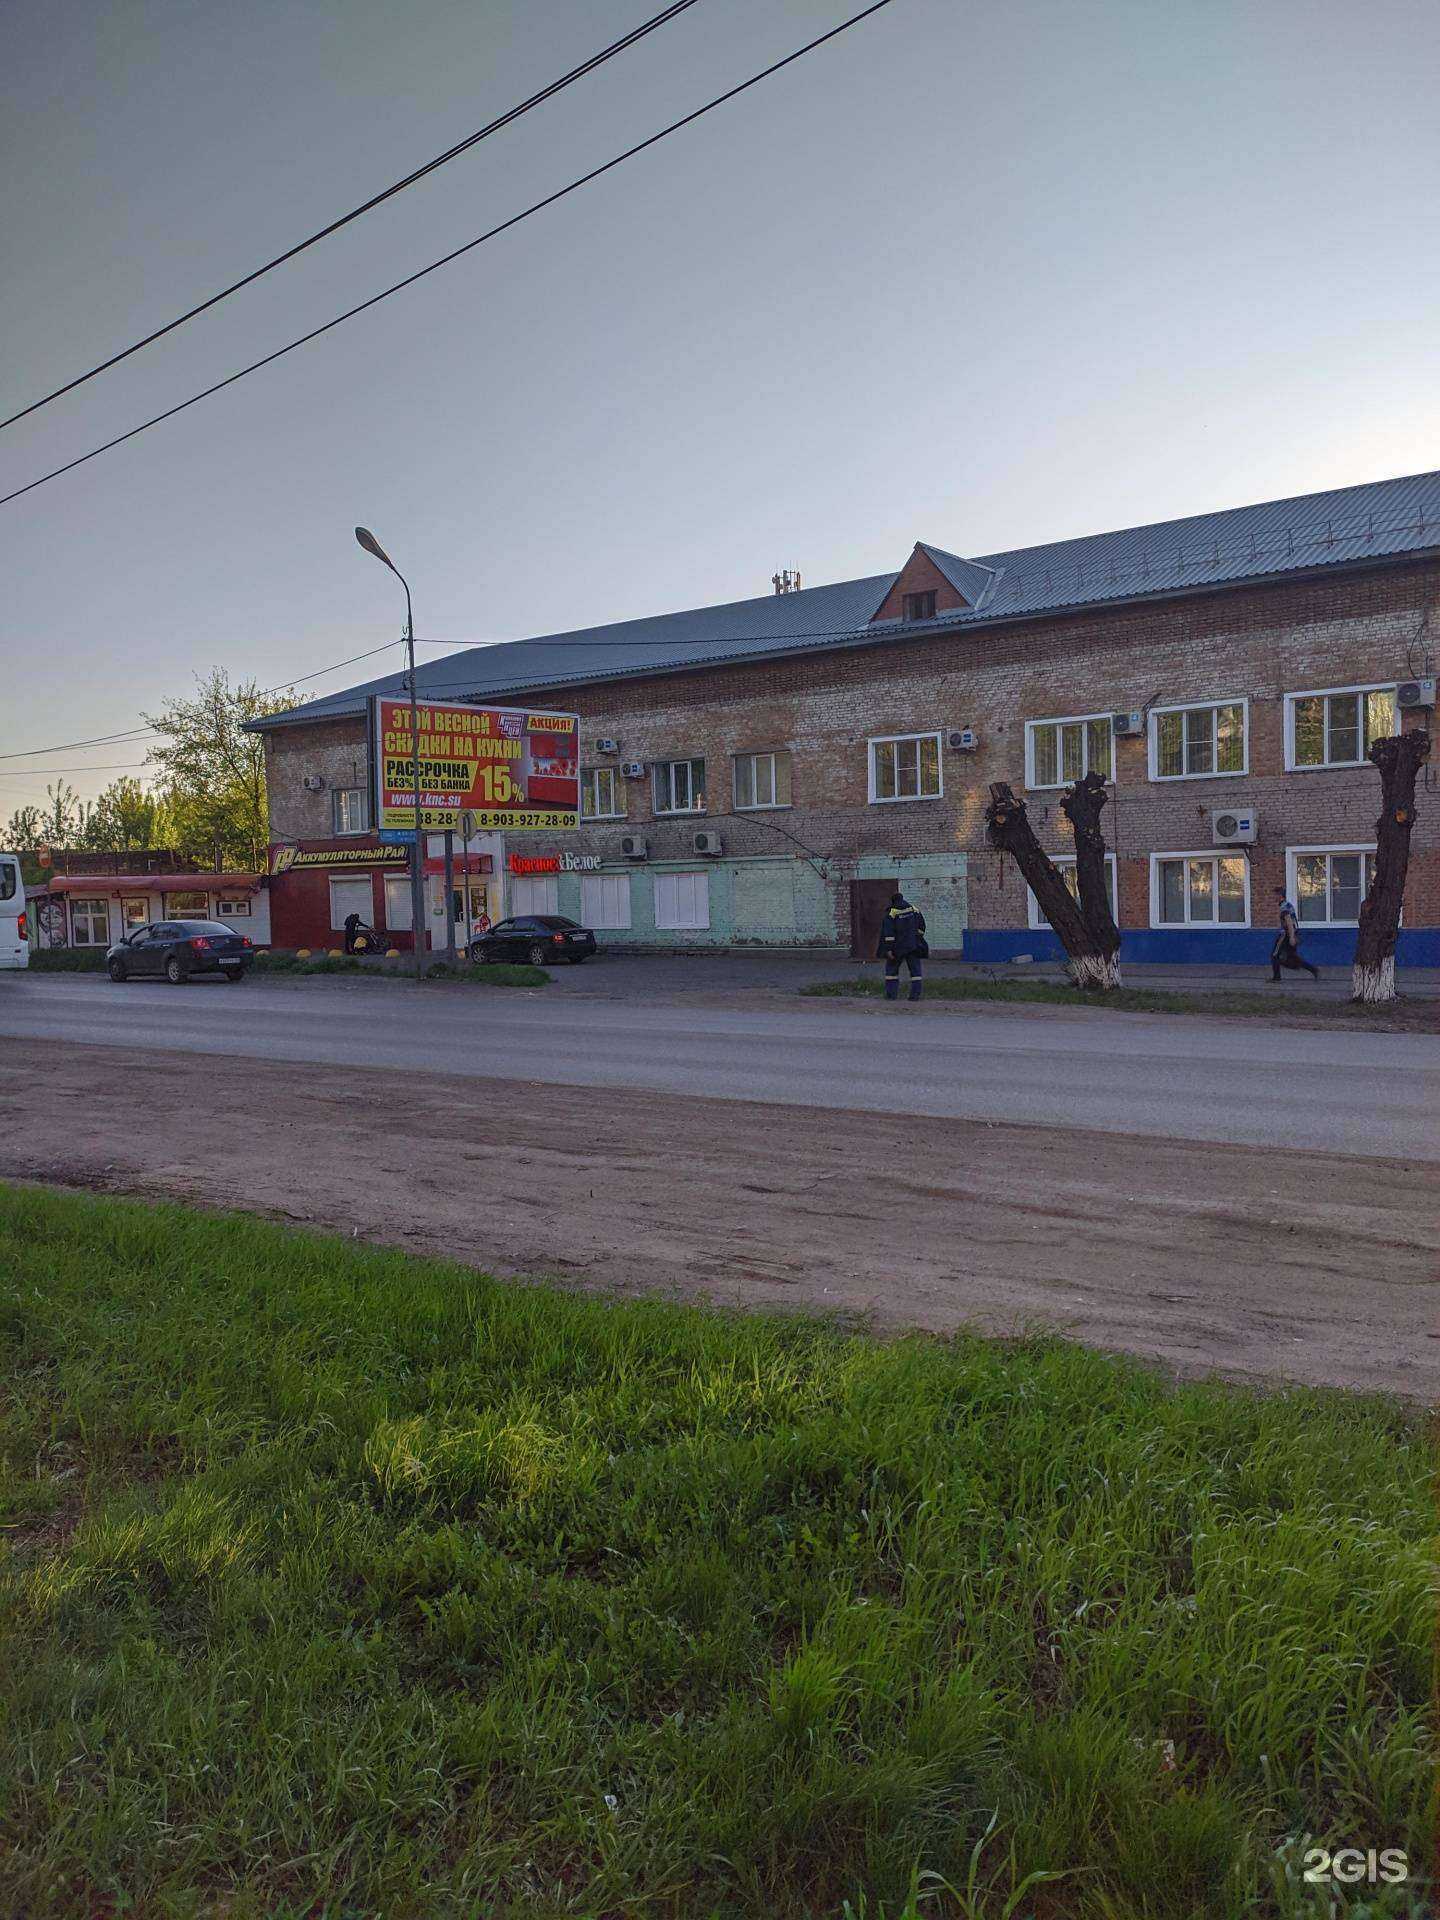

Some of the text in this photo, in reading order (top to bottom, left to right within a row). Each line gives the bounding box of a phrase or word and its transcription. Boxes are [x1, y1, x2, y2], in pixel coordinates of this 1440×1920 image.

[435, 712, 490, 735] ВЕСНОЙ
[530, 717, 571, 731] АКЦИЯ!
[453, 737, 473, 756] НА
[477, 737, 522, 759] КУХНИ
[422, 778, 438, 790] БЕЗ
[441, 778, 470, 791] БАНКА
[481, 812, 576, 827] 8-903-927-28-09
